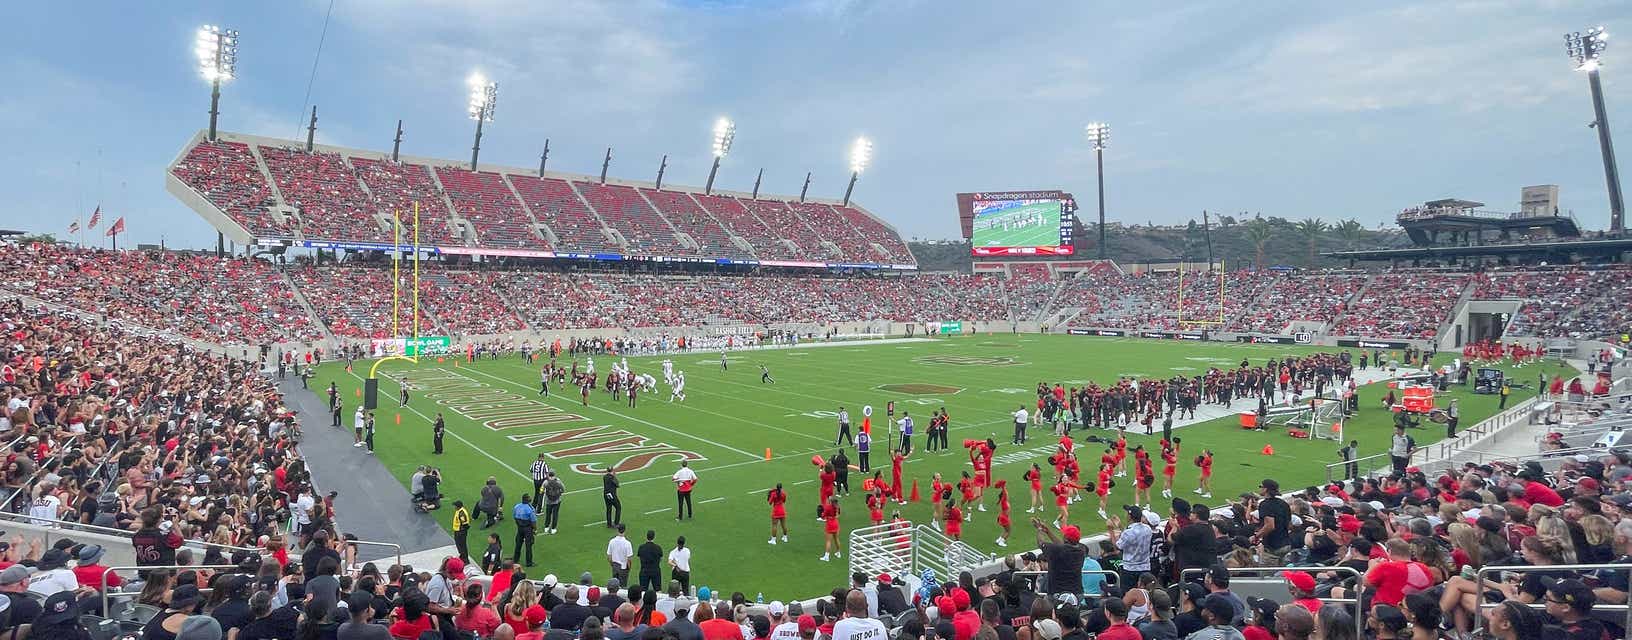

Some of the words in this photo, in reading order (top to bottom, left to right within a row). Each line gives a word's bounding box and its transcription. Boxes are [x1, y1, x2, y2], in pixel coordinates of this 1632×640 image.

[983, 191, 1028, 200] Snapdragon
[1029, 190, 1059, 199] stadium
[506, 424, 709, 475] SAN
